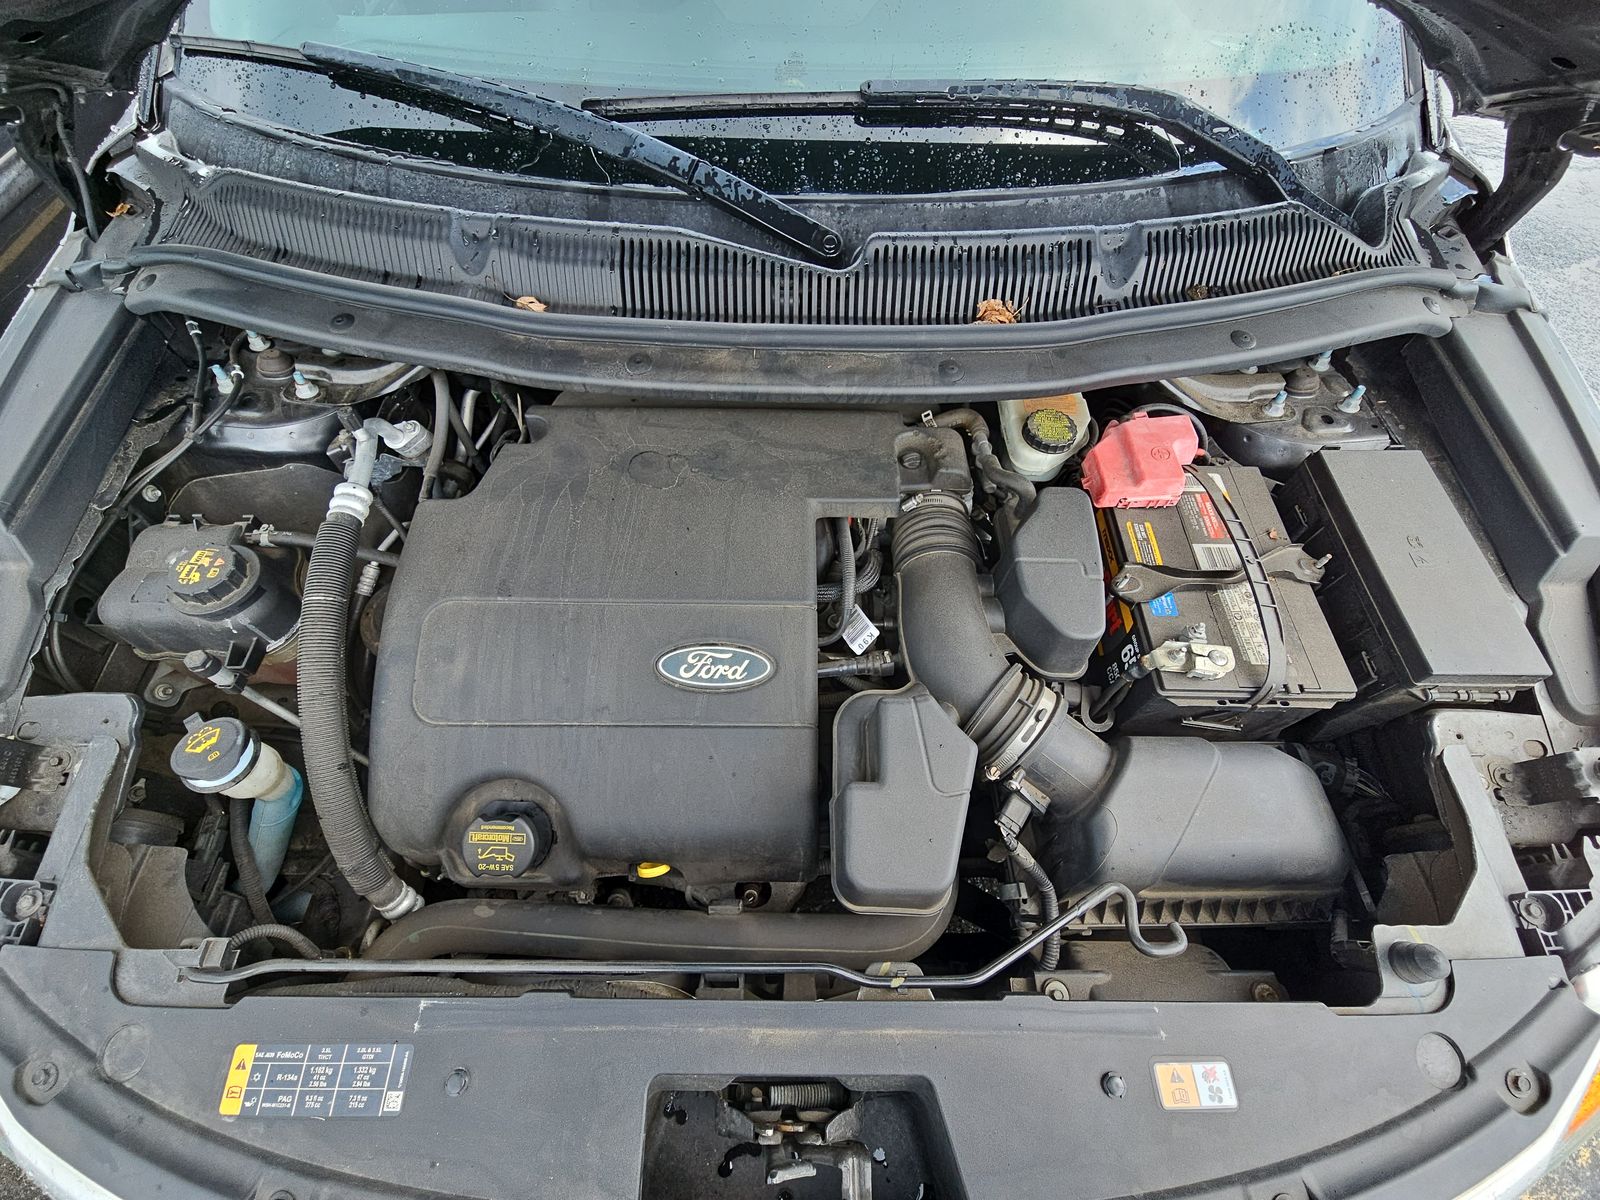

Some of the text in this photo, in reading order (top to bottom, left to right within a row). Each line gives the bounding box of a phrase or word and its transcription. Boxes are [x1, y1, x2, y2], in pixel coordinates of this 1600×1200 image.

[858, 631, 875, 650] K90
[679, 651, 750, 680] Ford
[472, 833, 511, 843] Motorcraft
[478, 863, 500, 871] 5W-20
[276, 1051, 304, 1059] FoMoCo
[325, 1067, 333, 1076] kg
[368, 1066, 377, 1075] kg
[276, 1073, 298, 1081] R-134a
[278, 1095, 292, 1103] PAG
